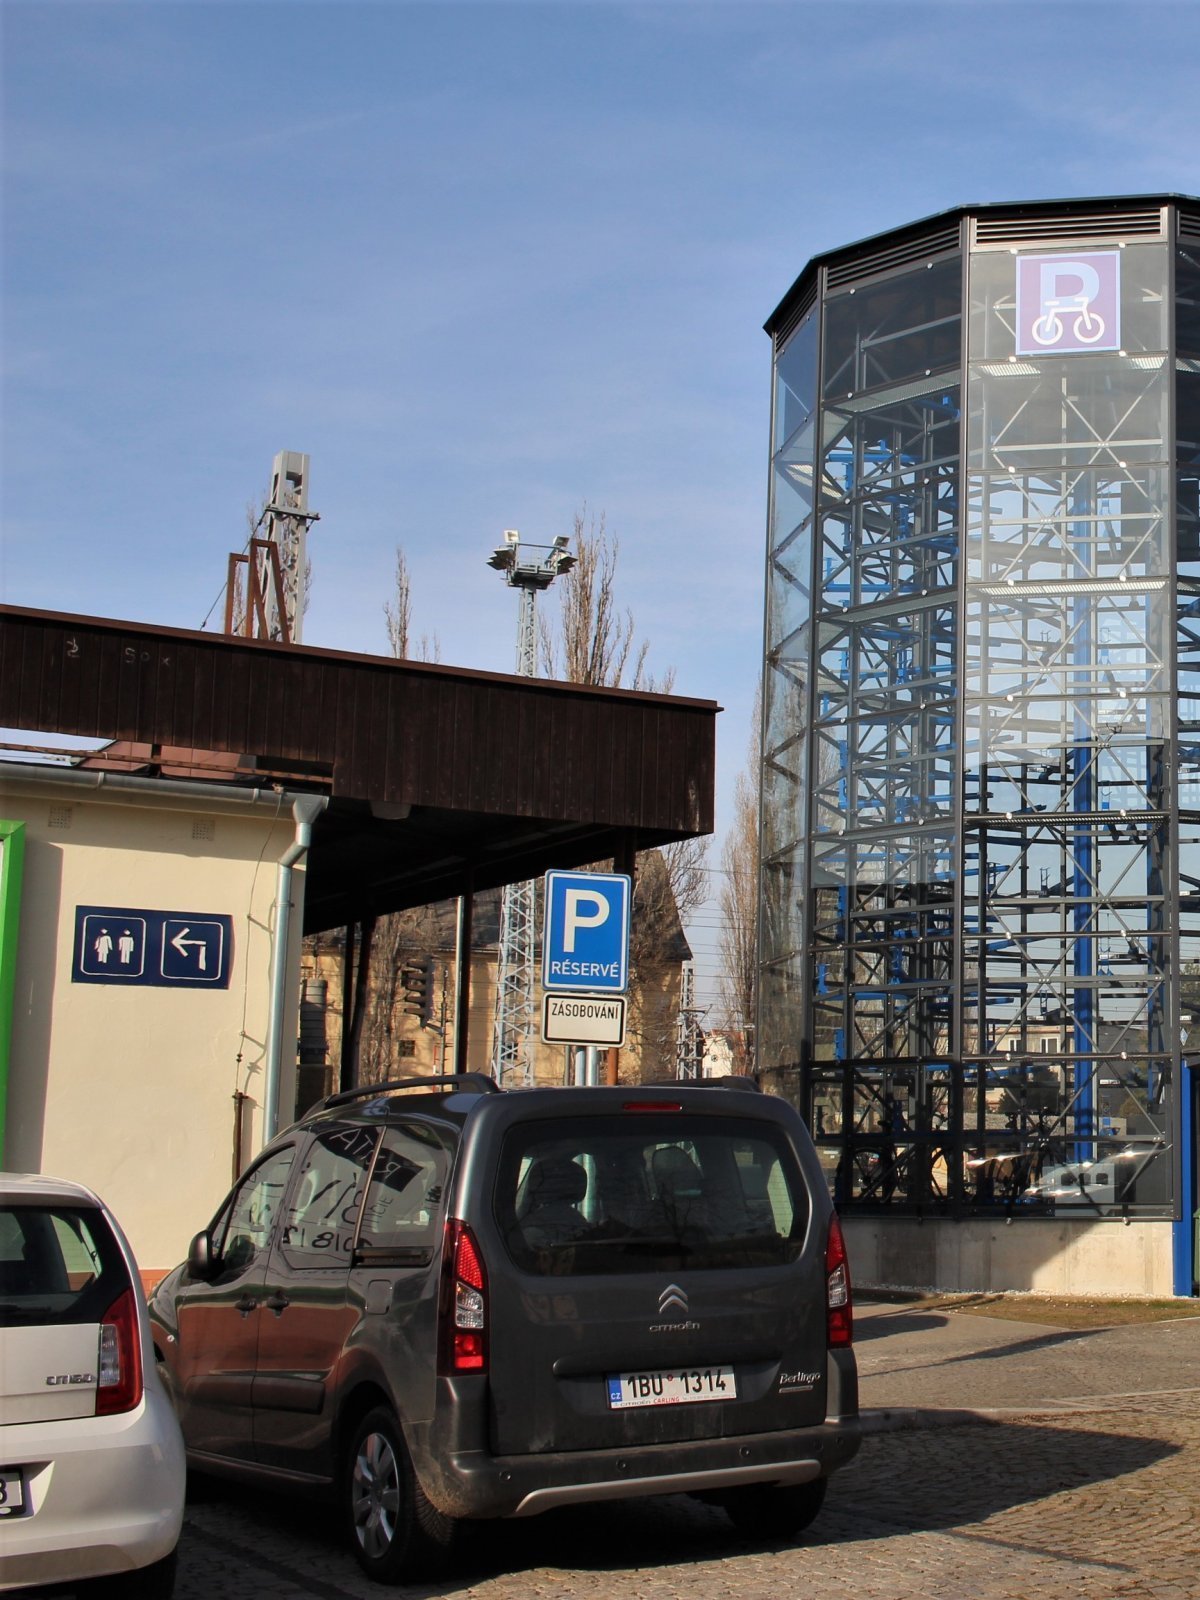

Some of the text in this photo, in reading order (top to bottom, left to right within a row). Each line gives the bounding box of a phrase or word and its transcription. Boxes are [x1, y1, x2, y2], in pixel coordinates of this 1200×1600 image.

[1040, 262, 1099, 339] P
[563, 888, 610, 953] P
[551, 959, 619, 978] RÉSERVÉ
[551, 1002, 619, 1020] ZÁSOBOVÁNÍ
[628, 1369, 726, 1398] 1BU 1314
[610, 1392, 621, 1400] CZ
